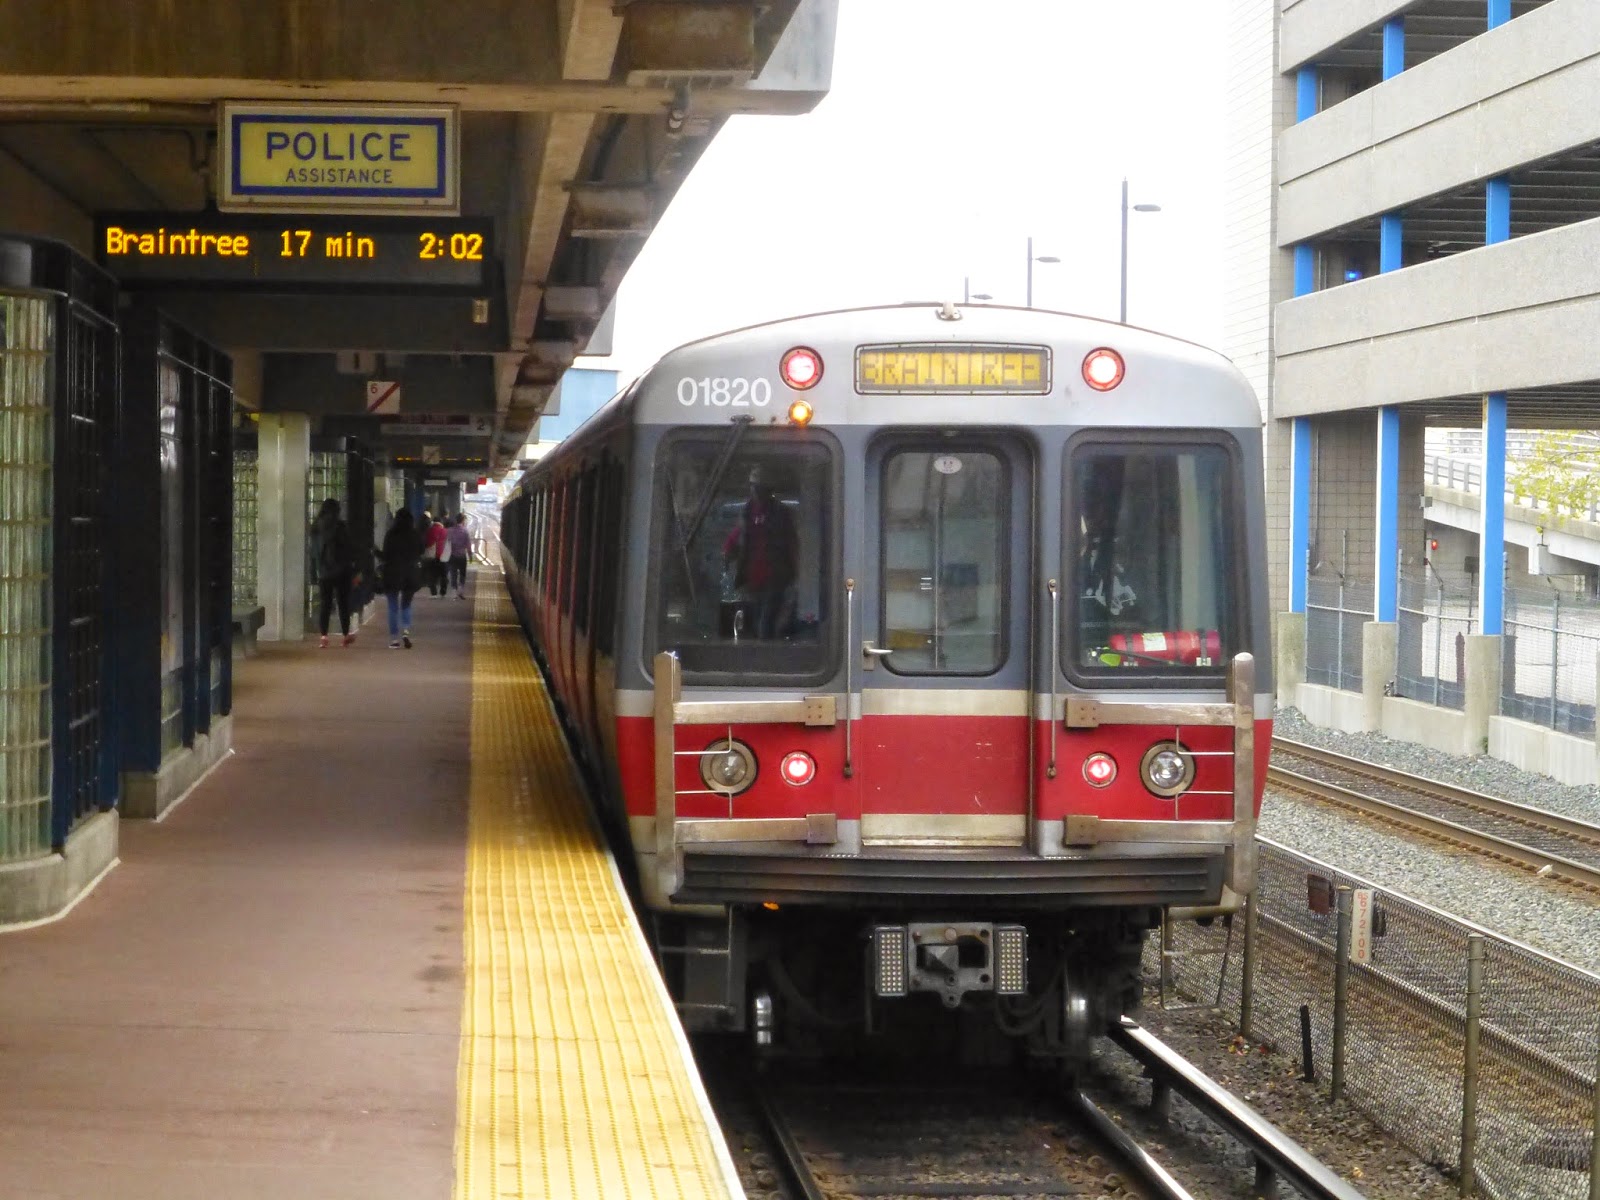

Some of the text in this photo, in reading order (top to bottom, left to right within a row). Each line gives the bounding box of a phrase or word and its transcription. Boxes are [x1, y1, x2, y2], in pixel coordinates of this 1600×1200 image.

[266, 131, 411, 162] POLICE
[286, 168, 393, 184] ASSISTANCE
[106, 227, 483, 260] Braintree 17 min 2:02
[370, 383, 378, 393] 6
[677, 377, 771, 406] 01820
